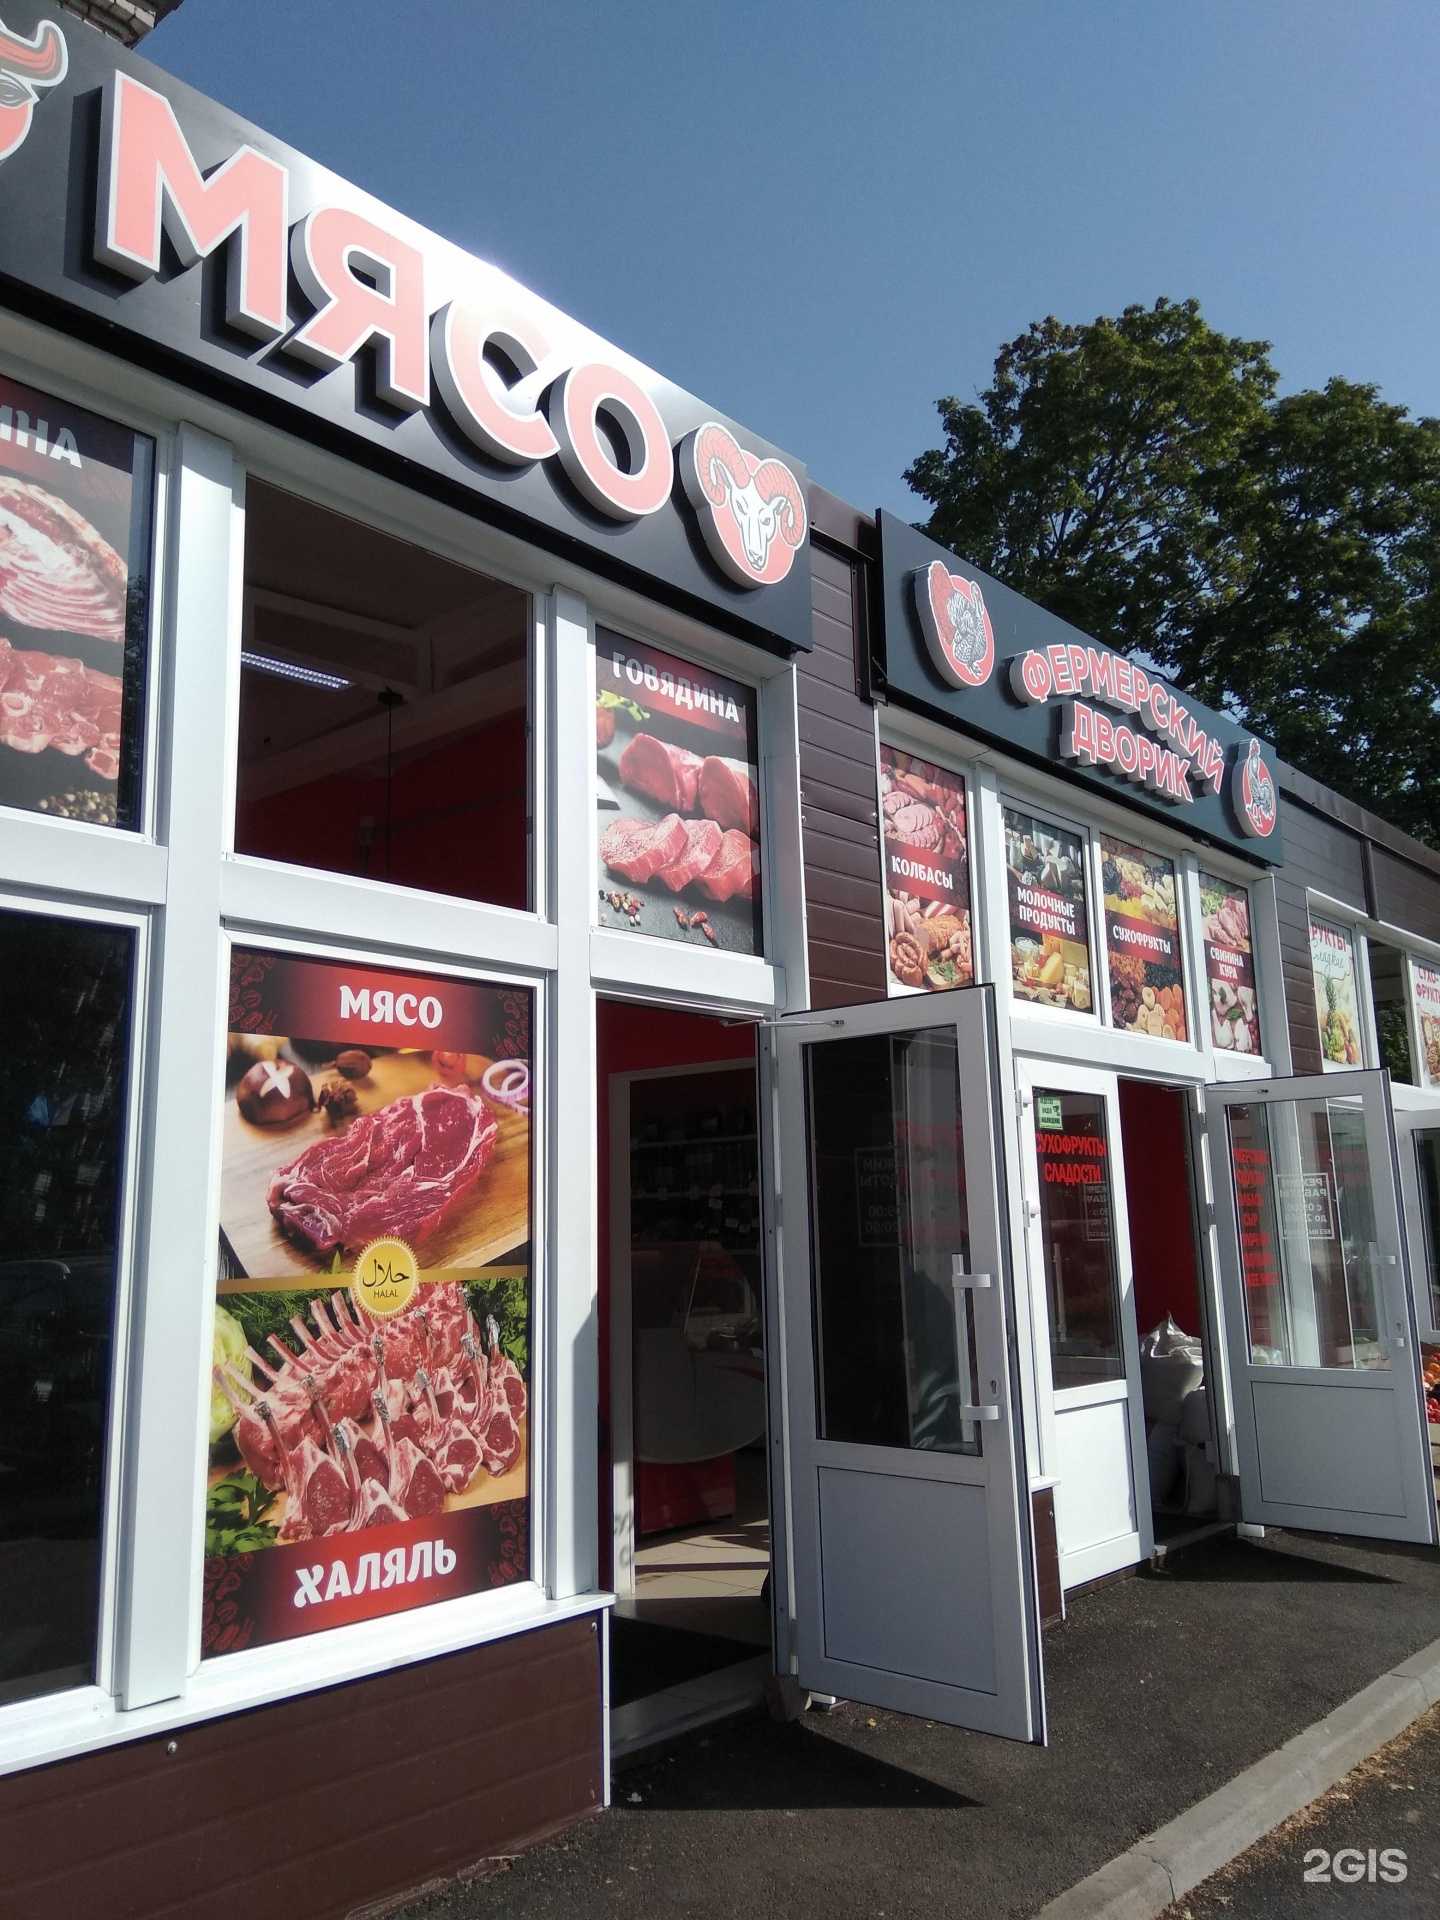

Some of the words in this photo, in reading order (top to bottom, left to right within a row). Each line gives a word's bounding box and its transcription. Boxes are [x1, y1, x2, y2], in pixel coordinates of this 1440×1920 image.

[104, 69, 674, 517] МЯСО
[612, 651, 740, 723] ГОВЯДИНА
[1022, 643, 1225, 794] ФЕРМЕРСКИЙ
[1071, 699, 1194, 803] ДВОРИК
[891, 855, 954, 890] КОЛБАСЫ
[1017, 886, 1076, 918] МОЛОЧНЫЕ
[1019, 904, 1076, 936] ПРОДУКТЫ
[1112, 924, 1172, 955] СУХОФРУКТЫ
[1310, 921, 1347, 952] РУКТЫ
[1210, 946, 1244, 968] СВИНИНА
[1218, 962, 1239, 980] КУРА
[339, 985, 443, 1029] МЯСО
[1036, 1133, 1107, 1157] СУХОФРУКТЫ
[1044, 1162, 1103, 1187] СЛАДОСТИ
[362, 1258, 410, 1288] حلال
[373, 1288, 399, 1299] HALAL
[293, 1539, 457, 1608] ХАЛЯЛЬ
